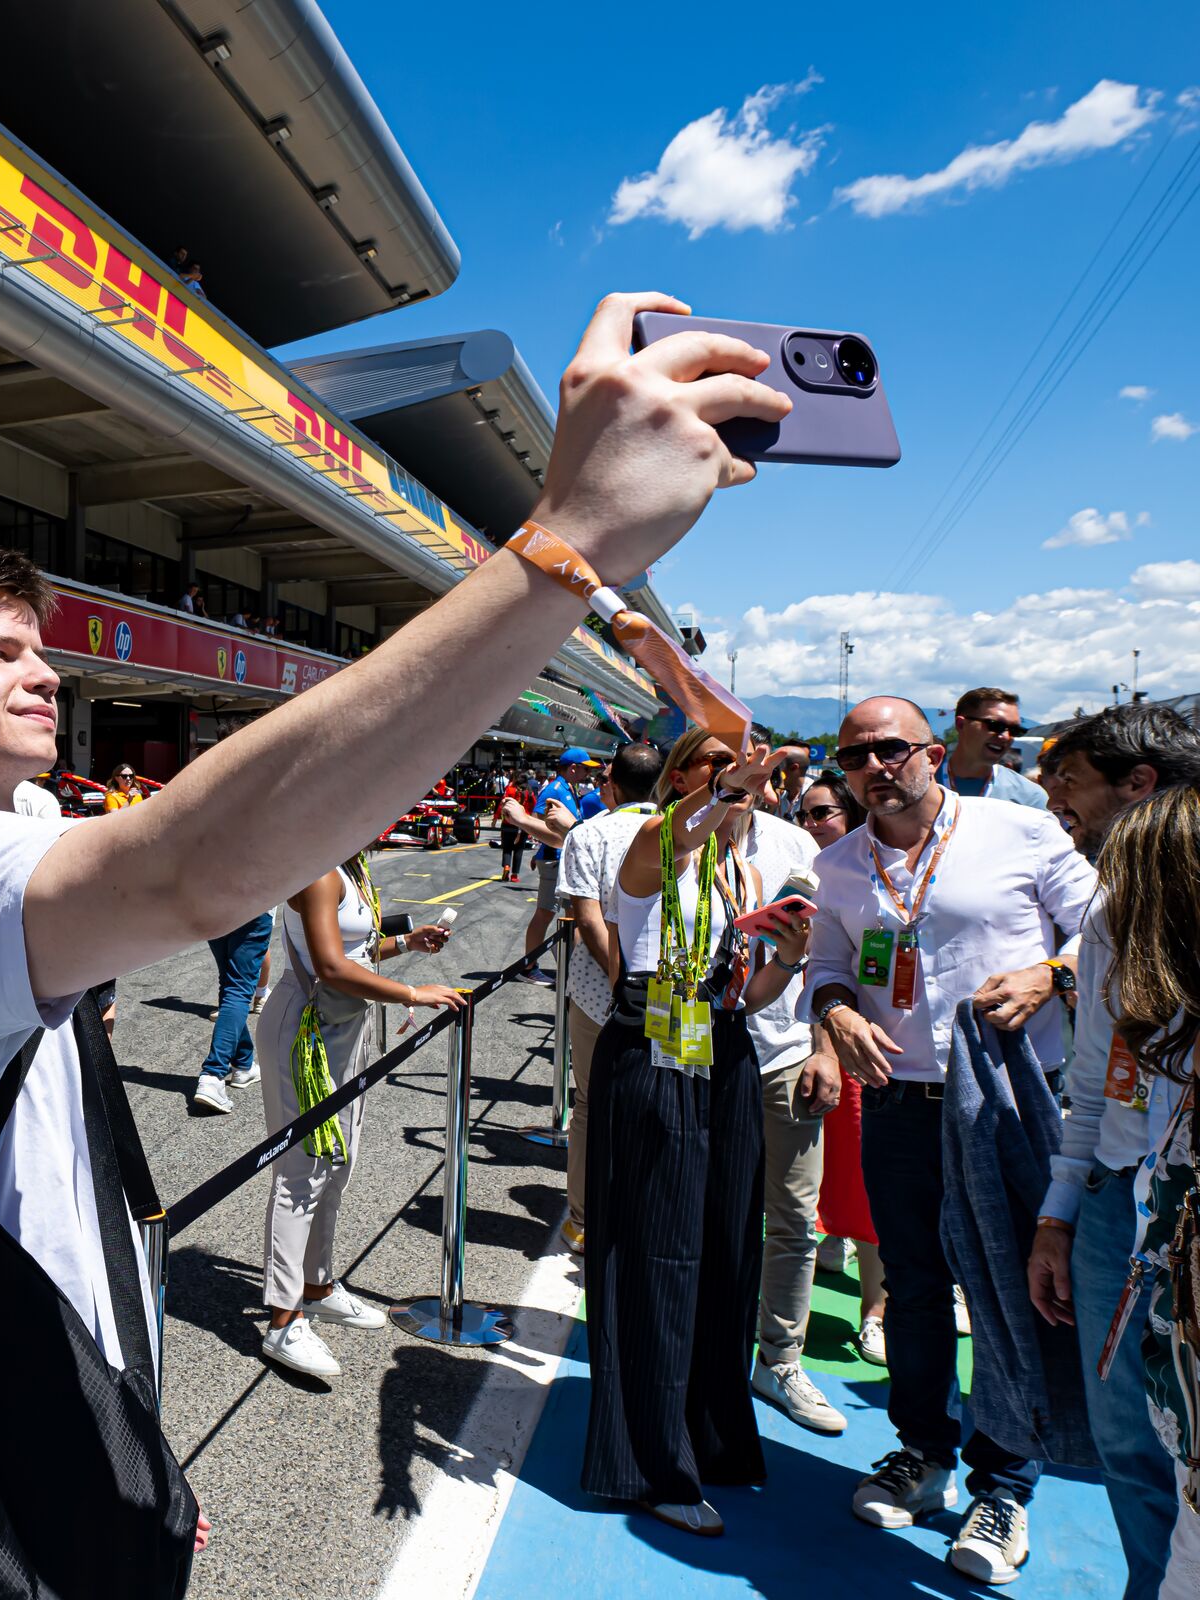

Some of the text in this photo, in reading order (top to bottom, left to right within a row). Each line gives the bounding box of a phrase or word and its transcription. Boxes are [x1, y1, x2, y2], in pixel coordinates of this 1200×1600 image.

[19, 174, 205, 376] DHL
[288, 390, 373, 498] DHL
[281, 662, 298, 693] 55
[256, 1137, 289, 1168] McLaren
